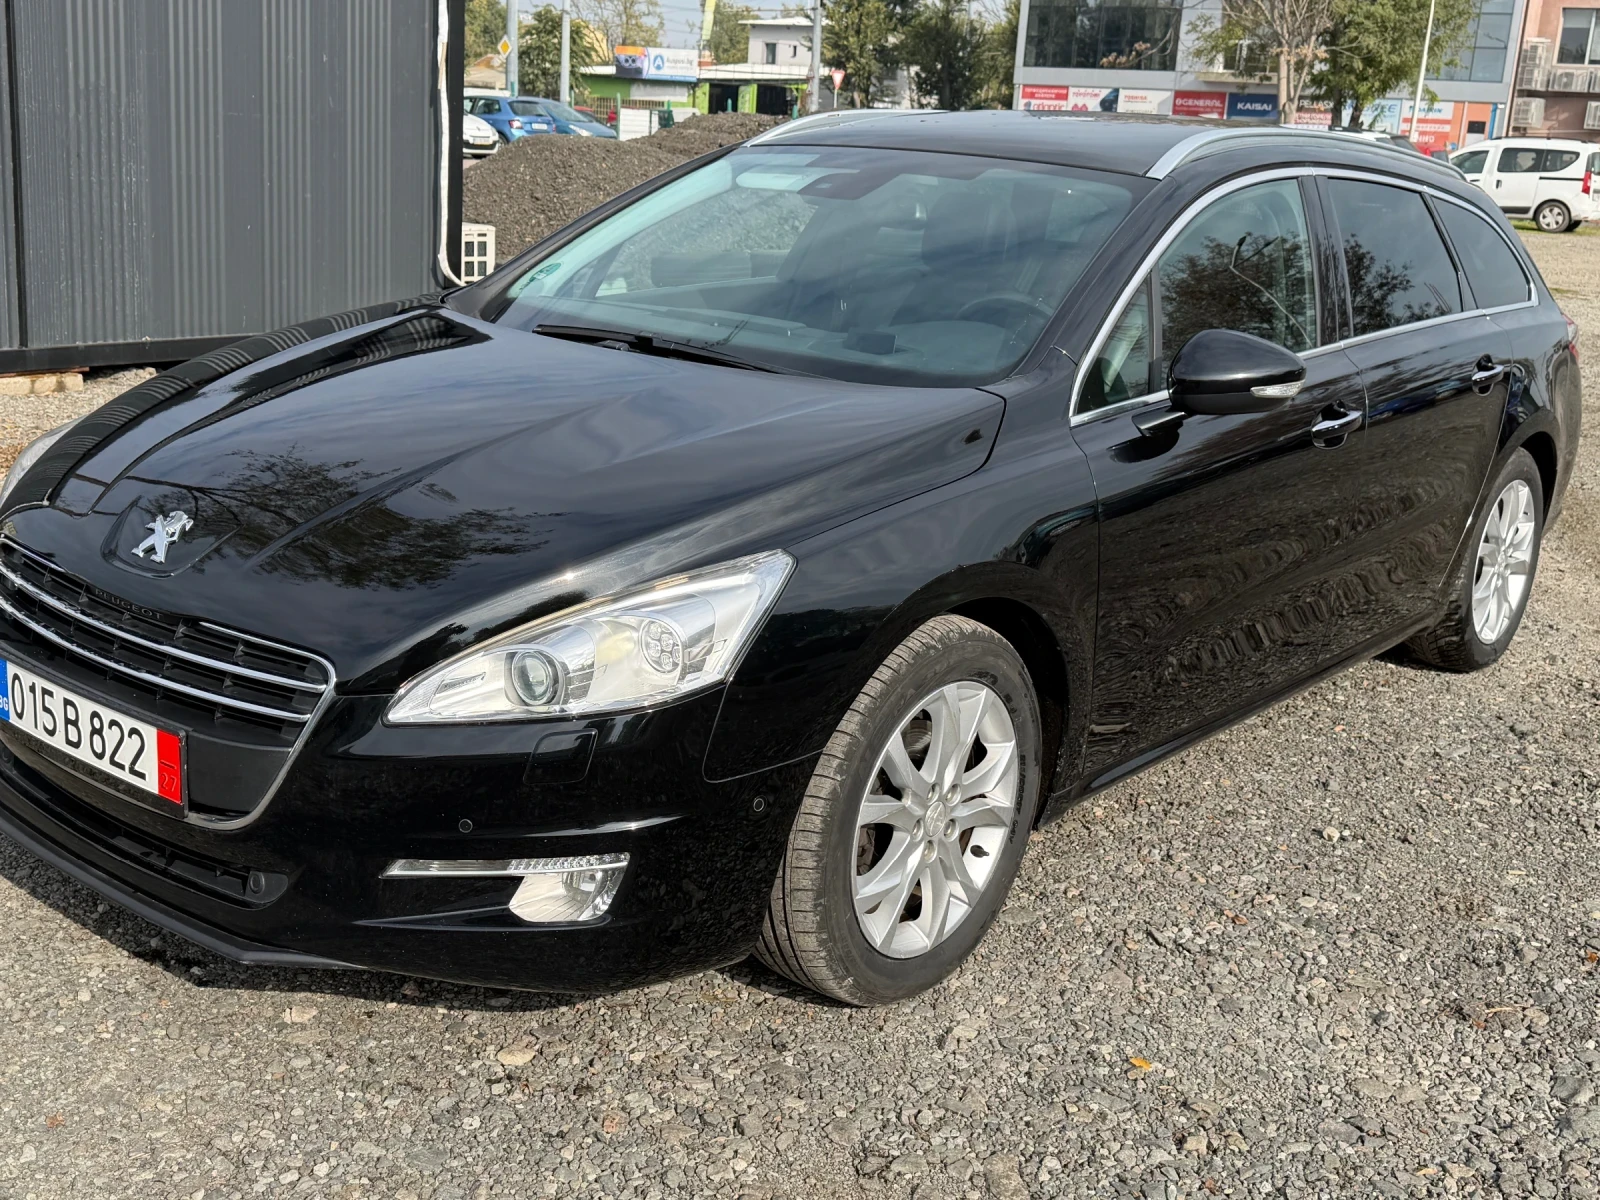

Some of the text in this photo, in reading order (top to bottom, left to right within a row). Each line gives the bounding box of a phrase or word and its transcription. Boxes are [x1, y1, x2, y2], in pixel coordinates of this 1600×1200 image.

[1182, 98, 1223, 108] GENERAL
[1237, 102, 1272, 111] KAISAI
[95, 588, 163, 619] PEUGEOT
[160, 772, 177, 792] 27
